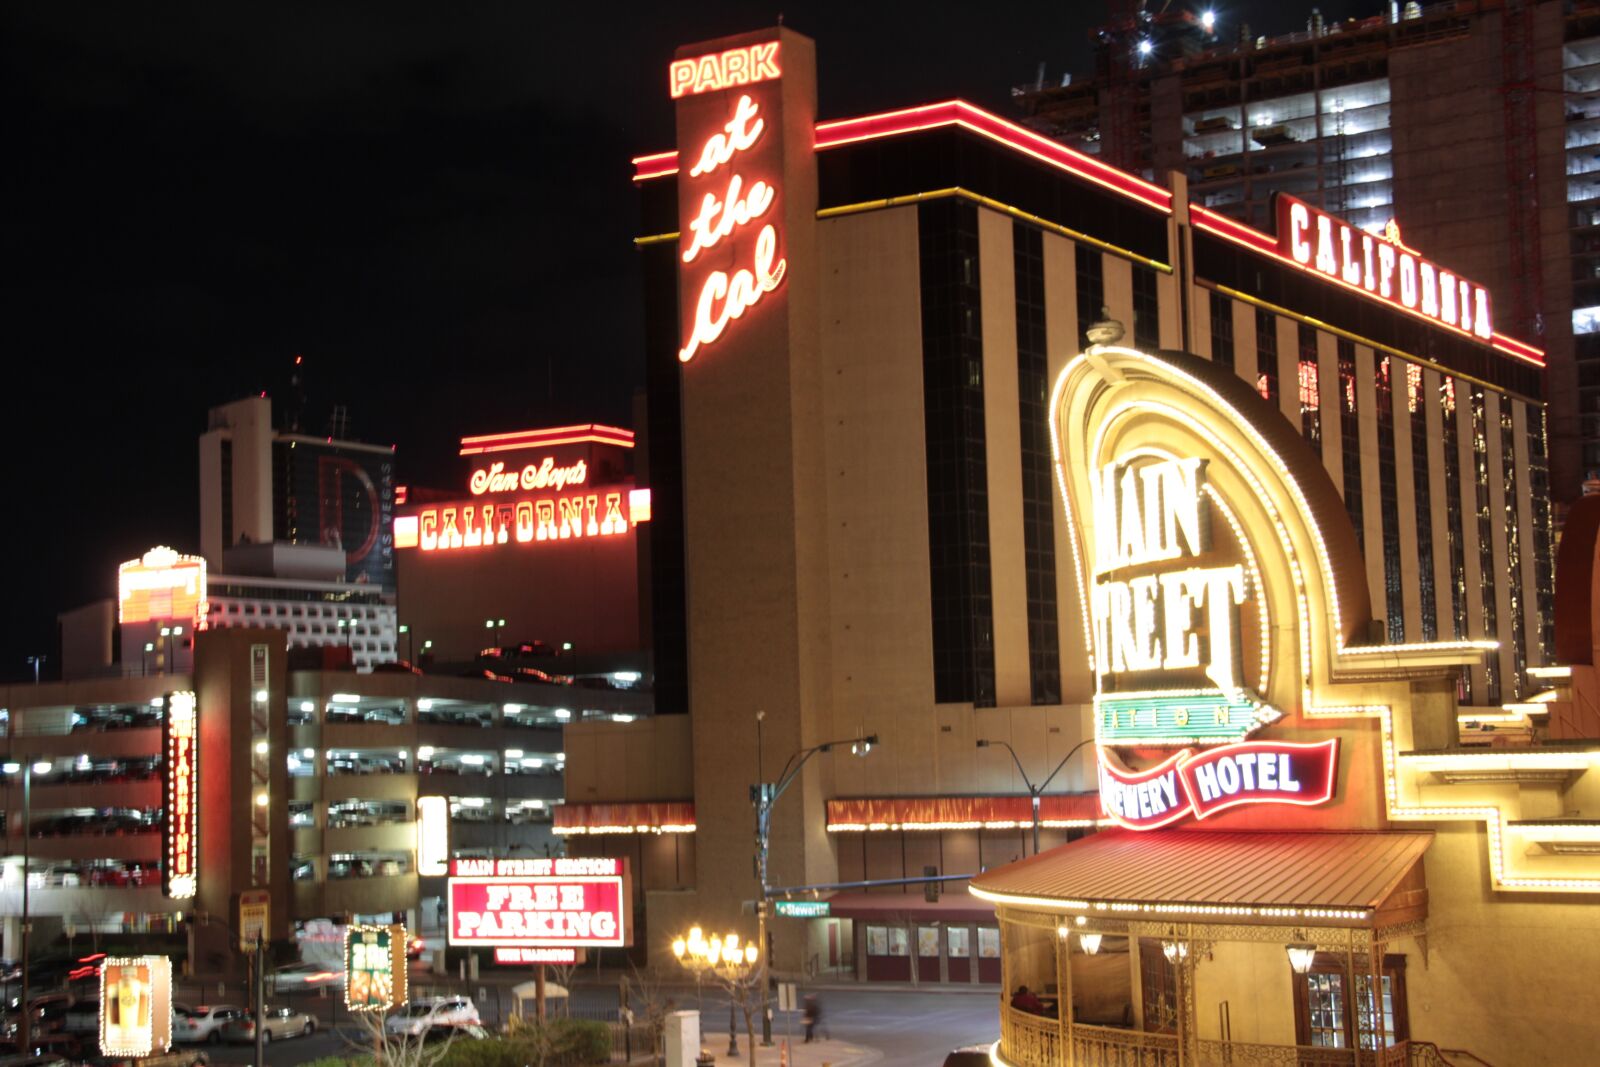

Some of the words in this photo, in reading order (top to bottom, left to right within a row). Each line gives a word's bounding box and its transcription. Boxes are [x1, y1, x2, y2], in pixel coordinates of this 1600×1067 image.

[670, 41, 782, 98] PARK
[690, 95, 764, 177] at
[682, 174, 774, 262] the
[678, 225, 786, 362] Cal
[1290, 203, 1491, 339] CALIFORNIA
[470, 461, 519, 495] Sam
[420, 493, 628, 551] CALIFORNIA
[1096, 563, 1245, 702] TREET
[176, 737, 189, 874] PARKING
[1100, 768, 1179, 819] EWERY
[1195, 752, 1300, 802] HOTEL
[456, 859, 494, 875] MAIN
[486, 885, 584, 910] FREE
[457, 911, 616, 937] PARKING
[786, 903, 820, 916] Stewart
